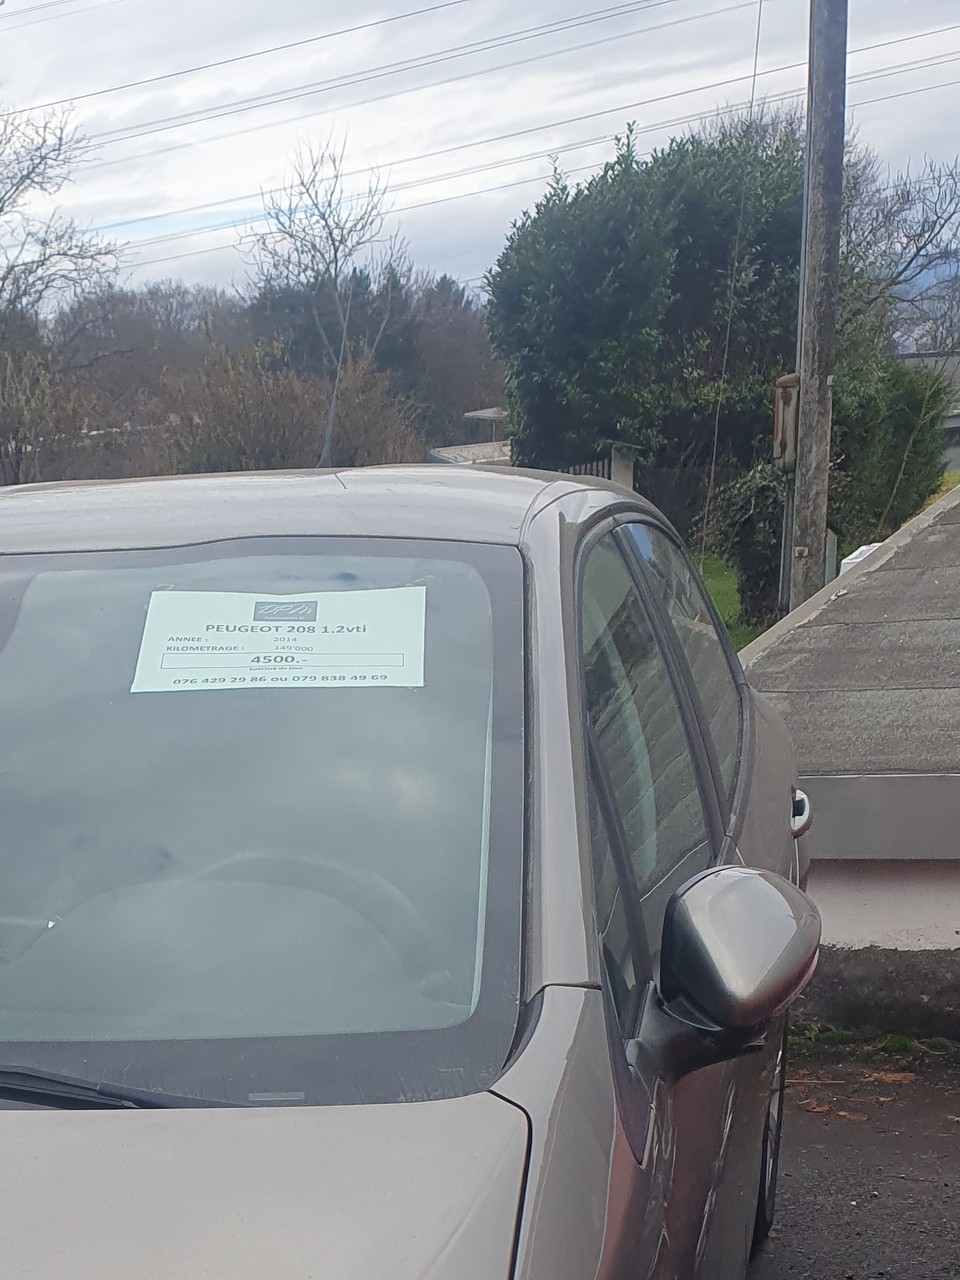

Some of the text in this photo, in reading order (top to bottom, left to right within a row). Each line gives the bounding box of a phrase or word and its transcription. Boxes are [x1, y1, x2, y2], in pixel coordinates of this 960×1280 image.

[205, 624, 367, 634] PEUGEOT 208 1.2vti
[250, 655, 308, 664] 4500.-
